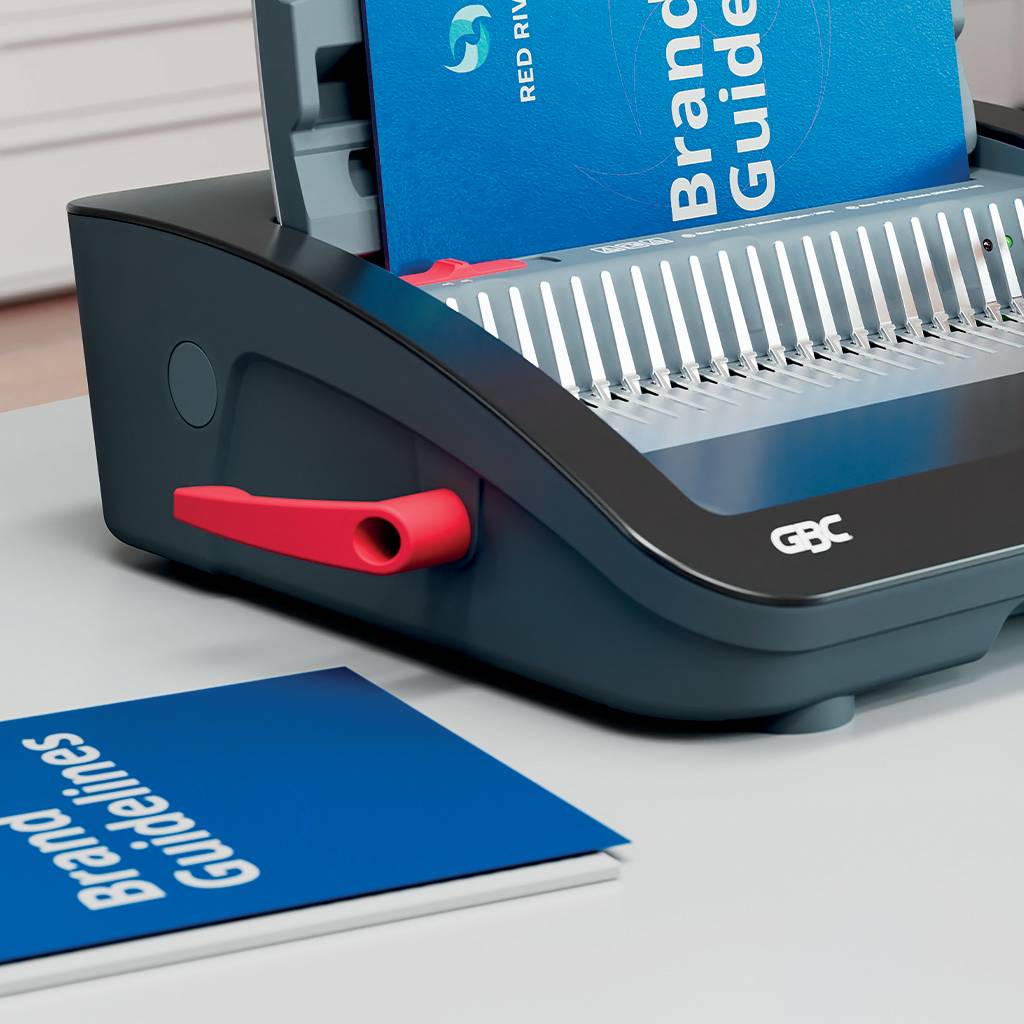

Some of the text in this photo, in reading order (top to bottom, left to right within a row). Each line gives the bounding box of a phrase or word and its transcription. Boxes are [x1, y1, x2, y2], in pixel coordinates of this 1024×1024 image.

[516, 47, 537, 104] RED
[770, 513, 854, 555] GBC
[21, 732, 261, 889] Guidelines
[0, 808, 166, 910] Brand
